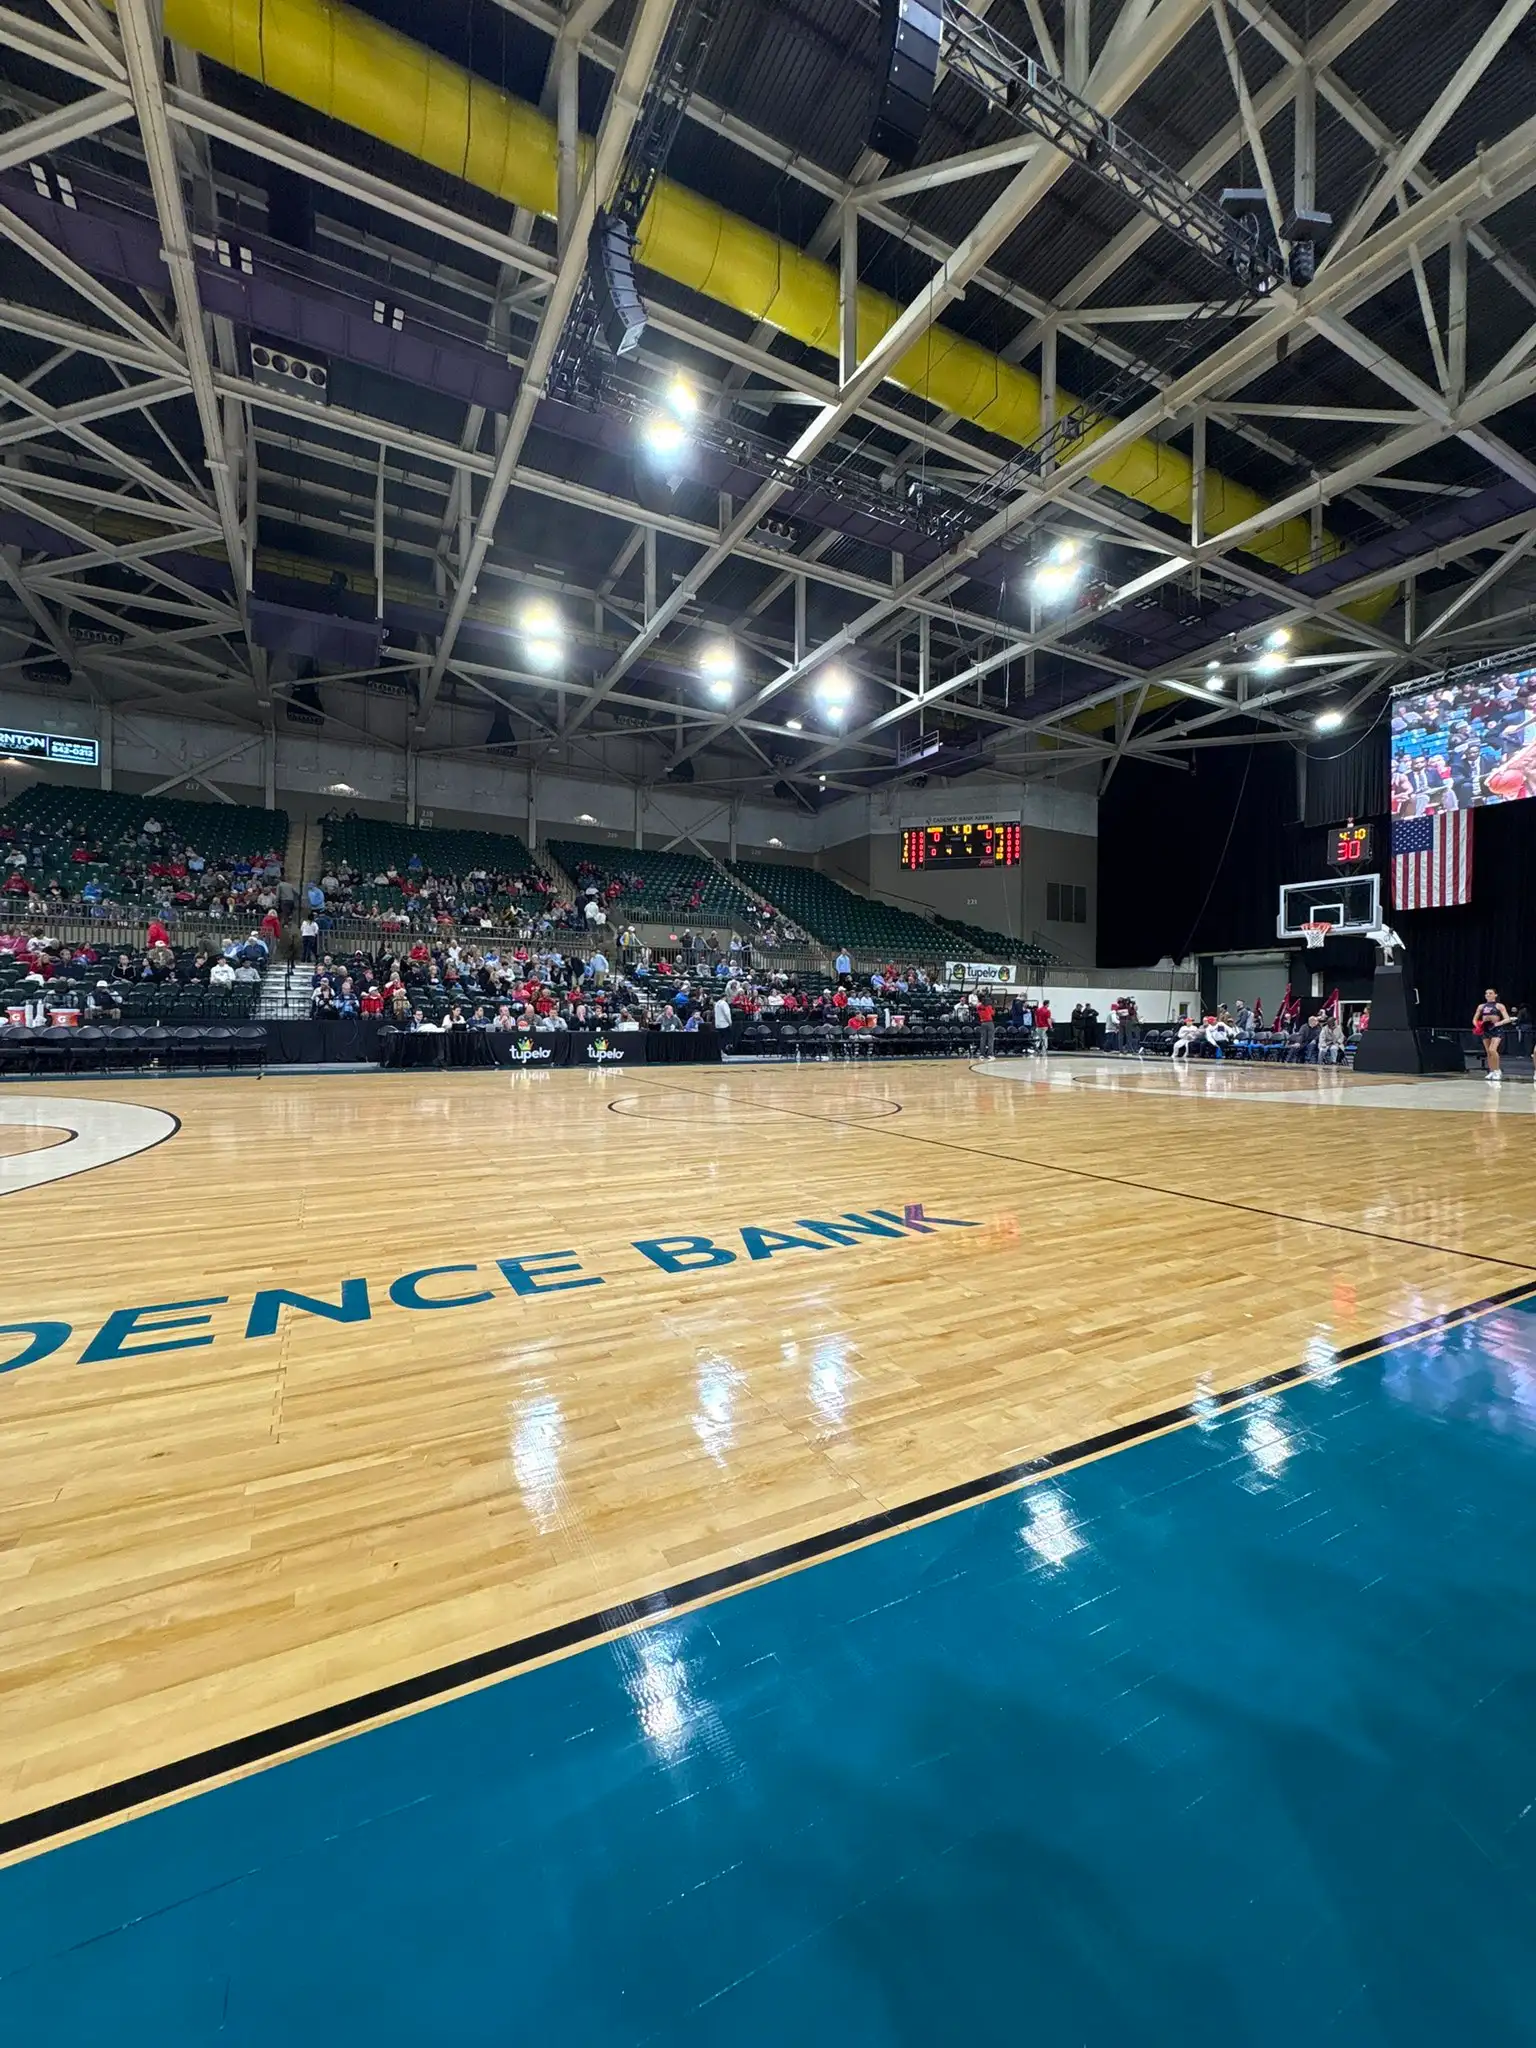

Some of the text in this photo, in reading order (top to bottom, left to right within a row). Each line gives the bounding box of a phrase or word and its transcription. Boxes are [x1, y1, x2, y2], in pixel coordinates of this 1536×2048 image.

[52, 745, 94, 757] 842-0212
[1339, 828, 1366, 840] 4:10
[1338, 840, 1360, 860] 30
[967, 963, 997, 978] tupelo
[11, 1013, 20, 1021] G
[57, 1015, 66, 1023] G
[509, 1044, 551, 1063] tupelo
[587, 1044, 625, 1063] tupelo
[630, 1202, 982, 1273] BANK
